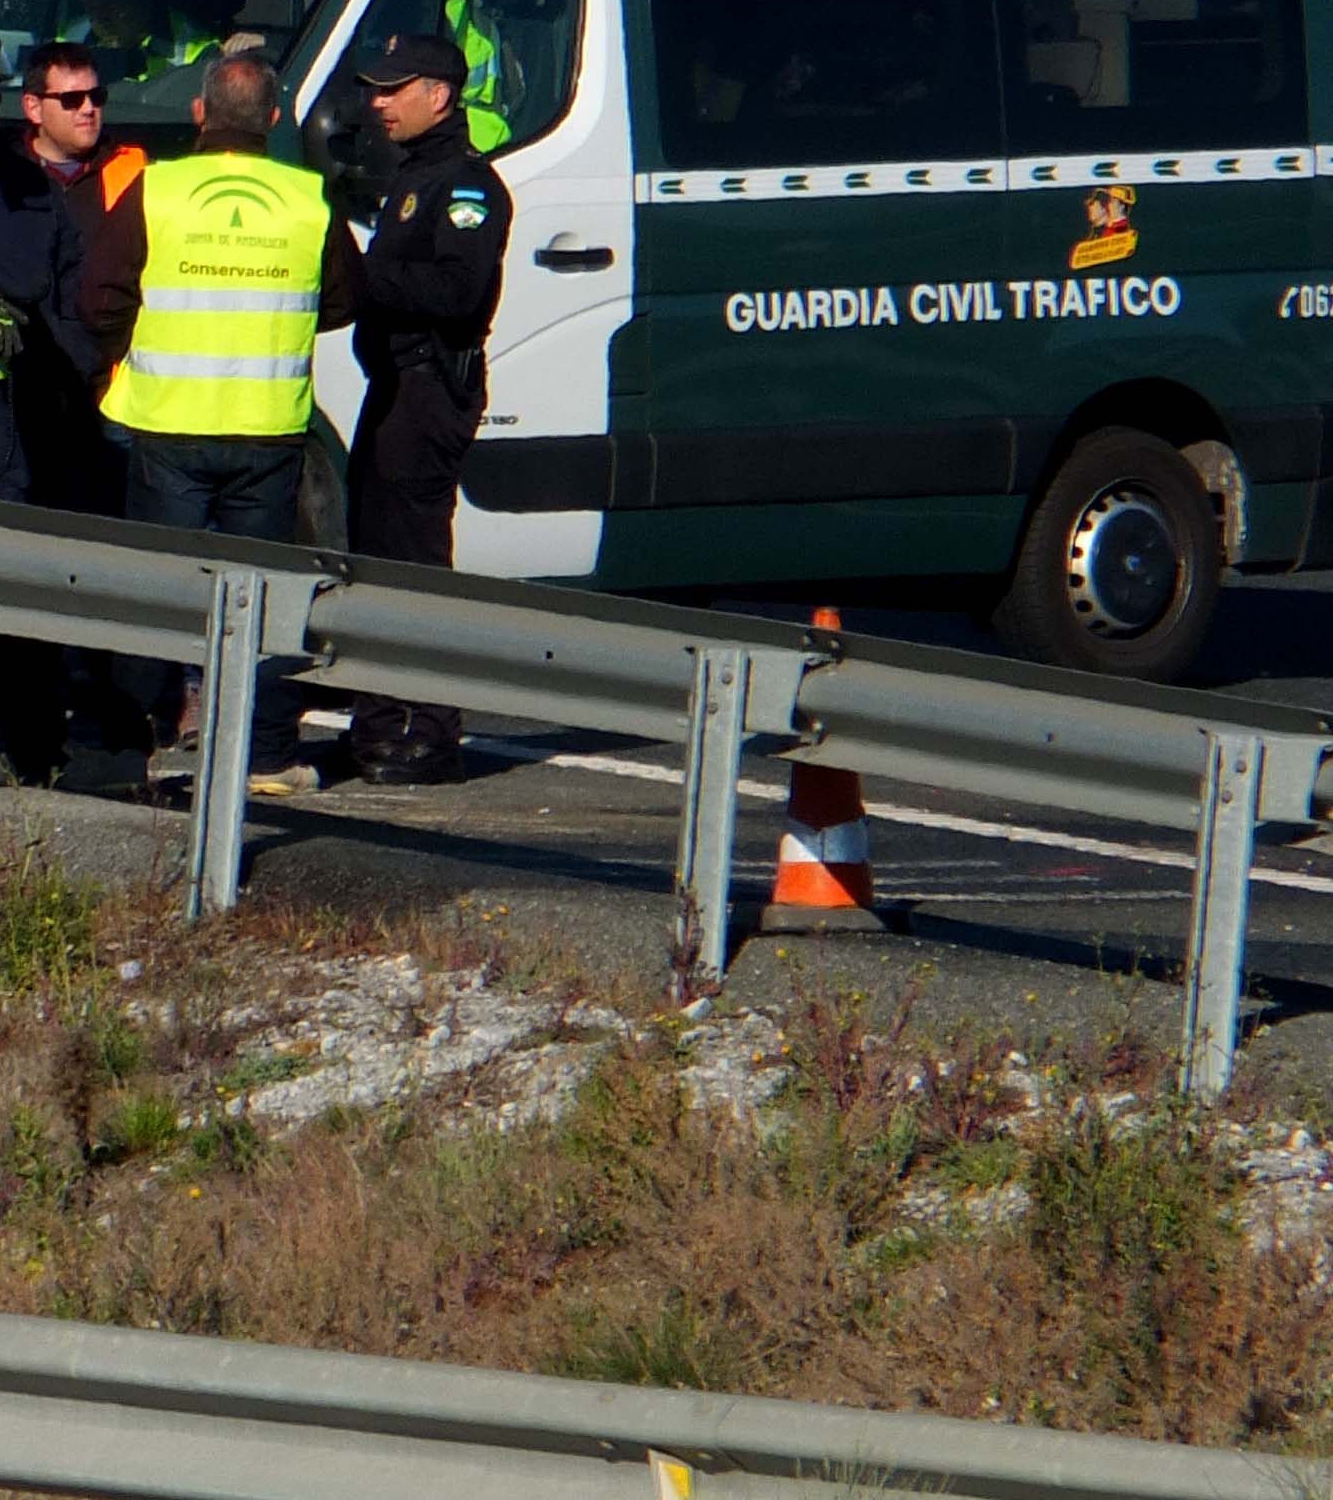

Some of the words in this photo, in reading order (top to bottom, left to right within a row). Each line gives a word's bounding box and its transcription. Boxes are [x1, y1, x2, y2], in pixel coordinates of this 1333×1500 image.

[178, 260, 290, 278] Conservación
[725, 285, 900, 333] GUARDIA
[909, 283, 1003, 325] CIVIL
[1007, 276, 1182, 319] TRAFICO
